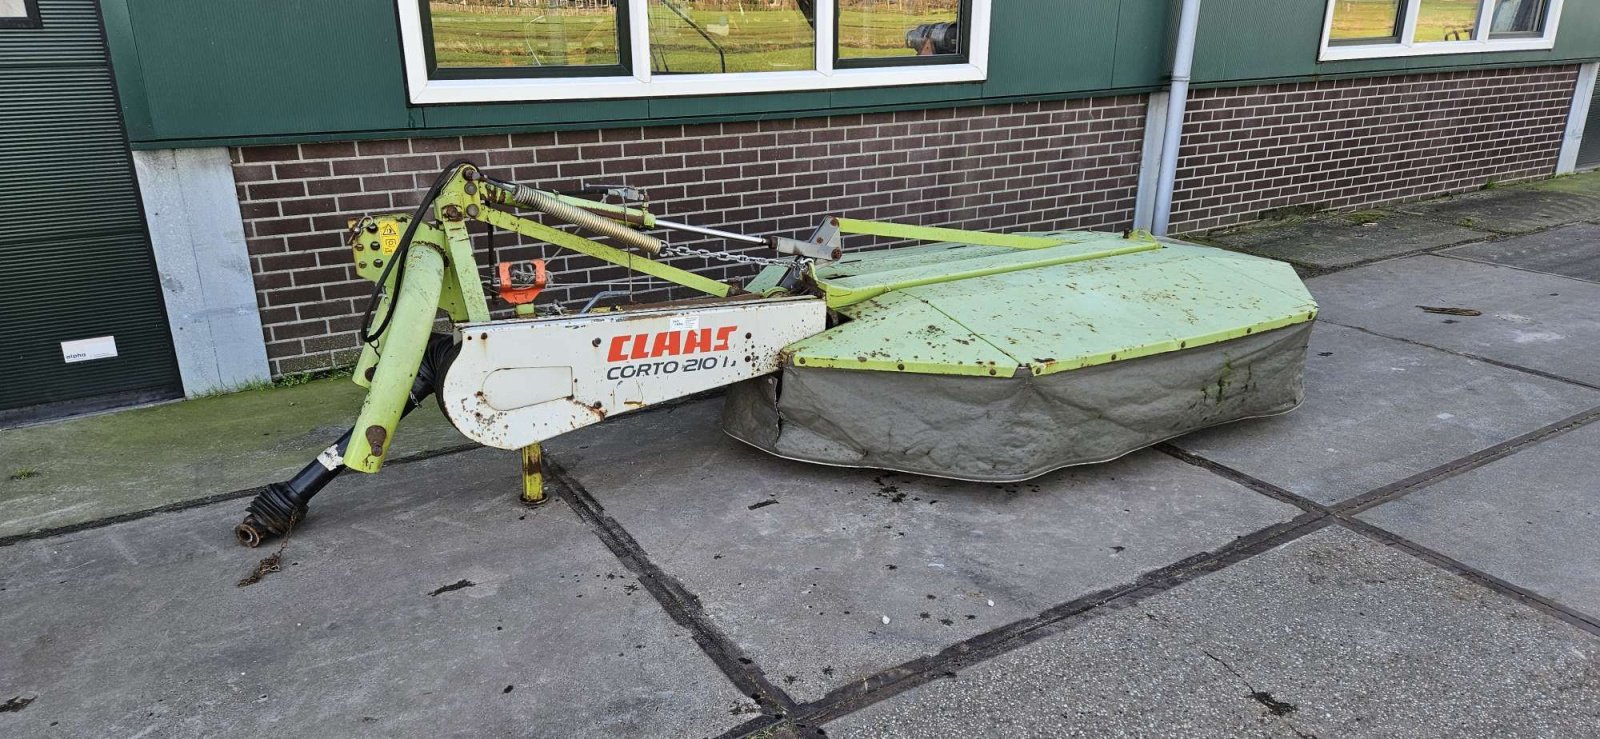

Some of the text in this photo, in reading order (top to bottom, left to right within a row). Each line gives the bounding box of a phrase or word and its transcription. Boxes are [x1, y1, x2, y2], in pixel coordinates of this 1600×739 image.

[607, 325, 738, 362] CLAAS
[607, 361, 679, 380] CORTO
[683, 357, 718, 373] 210
